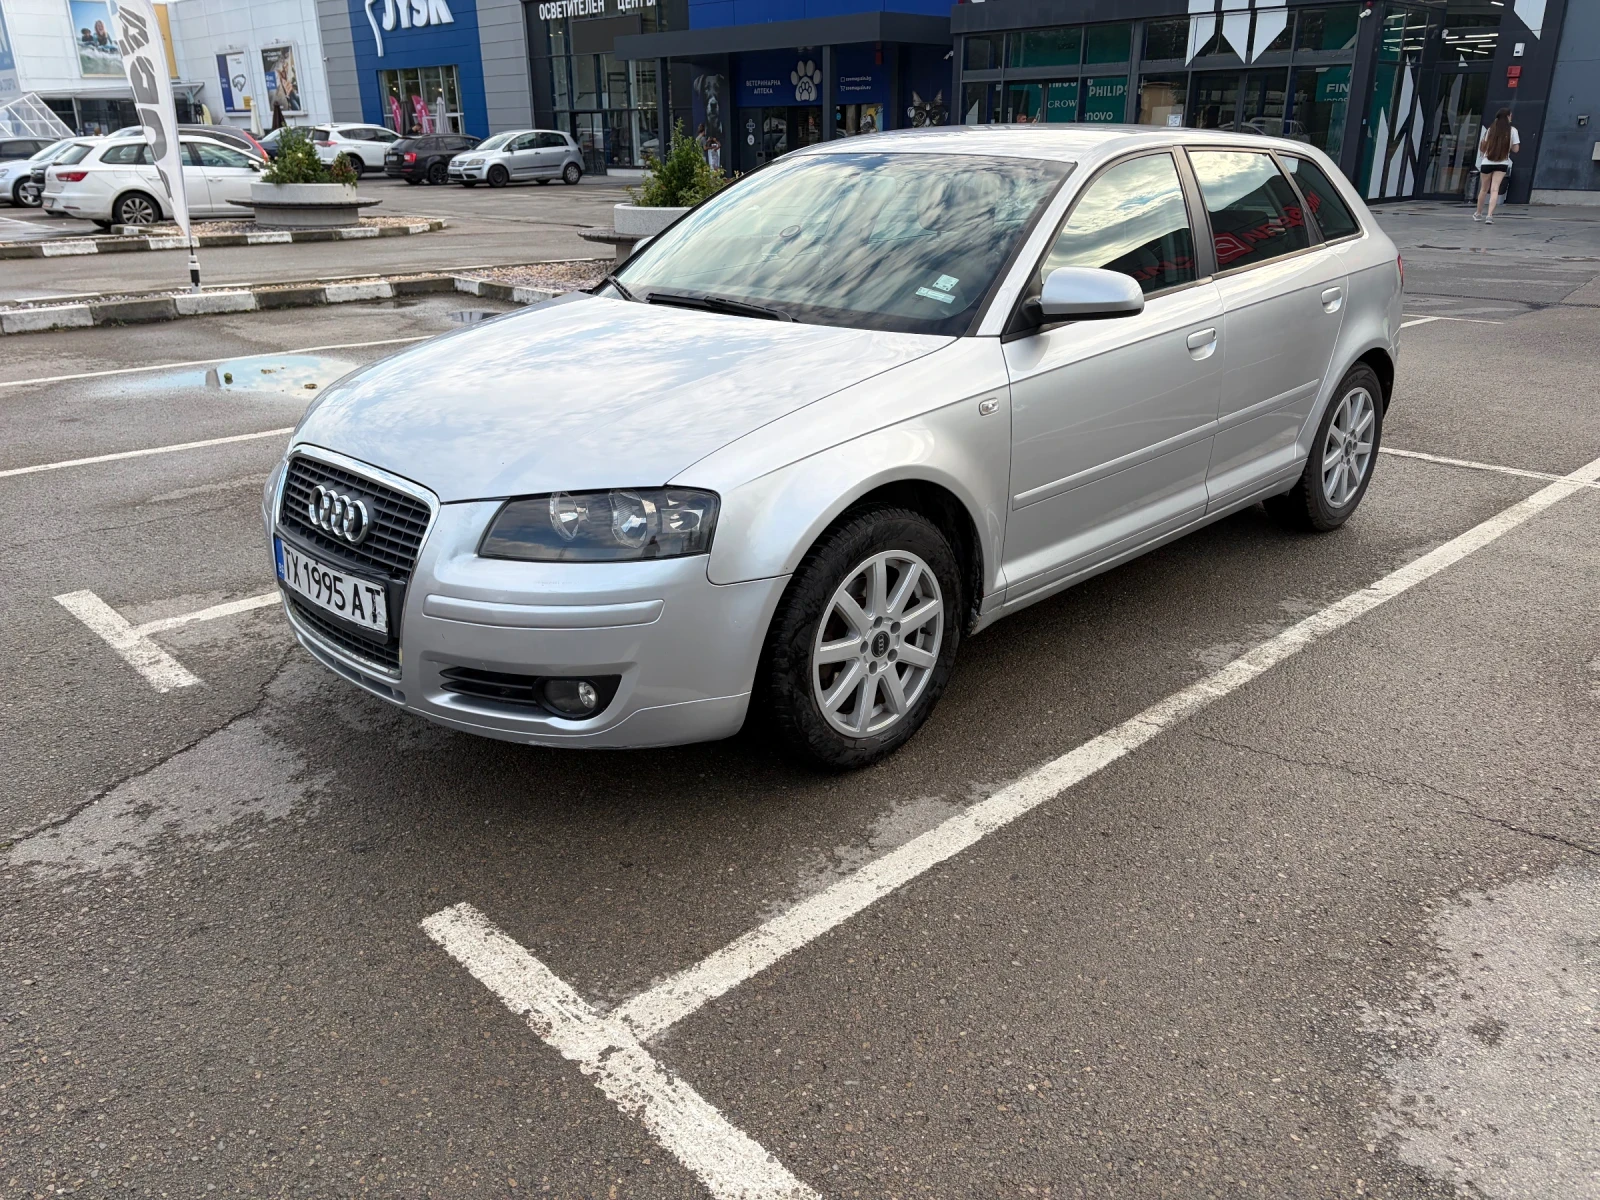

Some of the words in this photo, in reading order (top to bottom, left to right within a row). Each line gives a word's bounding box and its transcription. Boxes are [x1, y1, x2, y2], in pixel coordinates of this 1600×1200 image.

[382, 0, 454, 31] JYSK
[538, 0, 605, 21] ОСВЕТИТЕЛЕН
[745, 79, 781, 87] ВЕТЕРИНАРНА
[753, 87, 773, 95] АПТЕКА
[1047, 99, 1078, 109] CROW
[303, 562, 346, 611] 1995
[351, 583, 381, 624] AT
